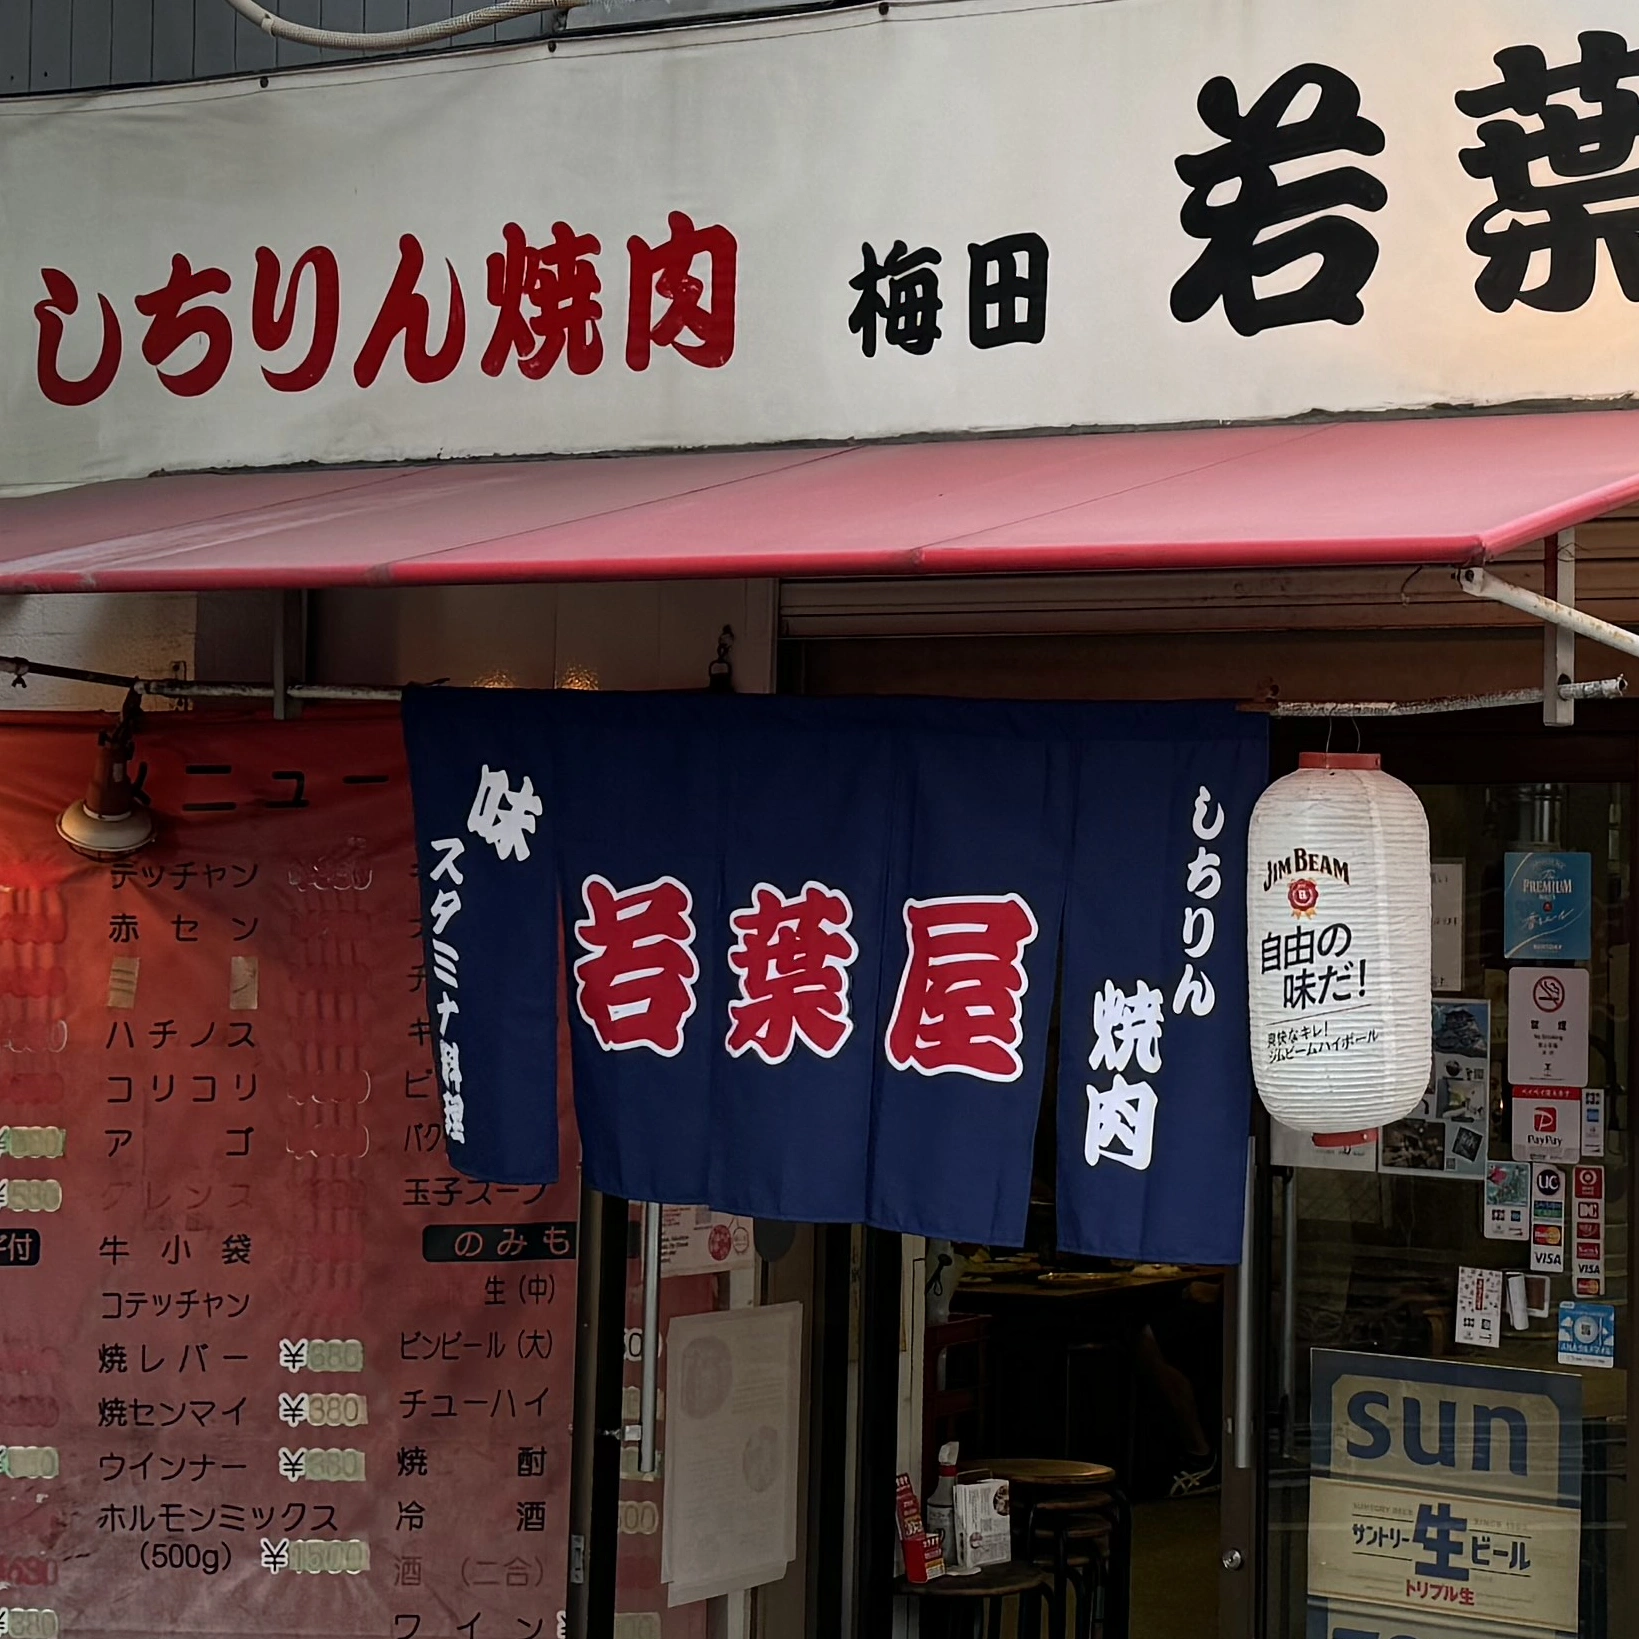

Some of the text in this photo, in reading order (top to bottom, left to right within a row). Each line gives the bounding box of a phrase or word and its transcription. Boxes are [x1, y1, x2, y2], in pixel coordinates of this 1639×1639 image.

[34, 211, 738, 406] しちりん焼肉
[848, 232, 1049, 357] 梅田
[468, 764, 543, 861] 味
[111, 861, 258, 890] テッチャン
[1264, 848, 1350, 892] JIM BEAM
[1172, 785, 1225, 1016] しちりん
[1523, 879, 1572, 894] PREMIUM
[108, 914, 259, 943] 赤セン
[1261, 923, 1352, 975] 自由の
[574, 874, 1038, 1082] 若葉屋
[1283, 959, 1366, 1011] 味だ!
[106, 1020, 256, 1049] ハチノス
[107, 1074, 257, 1103] コリコリ
[1084, 978, 1165, 1169] 焼肉
[104, 1126, 255, 1157] アゴ
[1527, 1134, 1564, 1147] PayPay
[1538, 1174, 1559, 1190] UC
[99, 1234, 252, 1265] 牛小袋
[454, 1226, 570, 1257] のみも
[1535, 1252, 1561, 1265] VISA
[1578, 1264, 1600, 1274] VISA
[102, 1289, 250, 1319] コテッチャン
[98, 1343, 248, 1373] 焼レバー
[98, 1397, 247, 1427] 焼センマイ
[399, 1387, 548, 1418] チューハイ
[1347, 1391, 1528, 1477] sun
[99, 1452, 247, 1482] ウインナー
[397, 1446, 547, 1477] 焼酎
[98, 1502, 338, 1532] ホルモンミックス
[396, 1501, 546, 1531] 冷酒
[140, 1541, 232, 1574] (500g)
[1406, 1579, 1475, 1605] トリプル生
